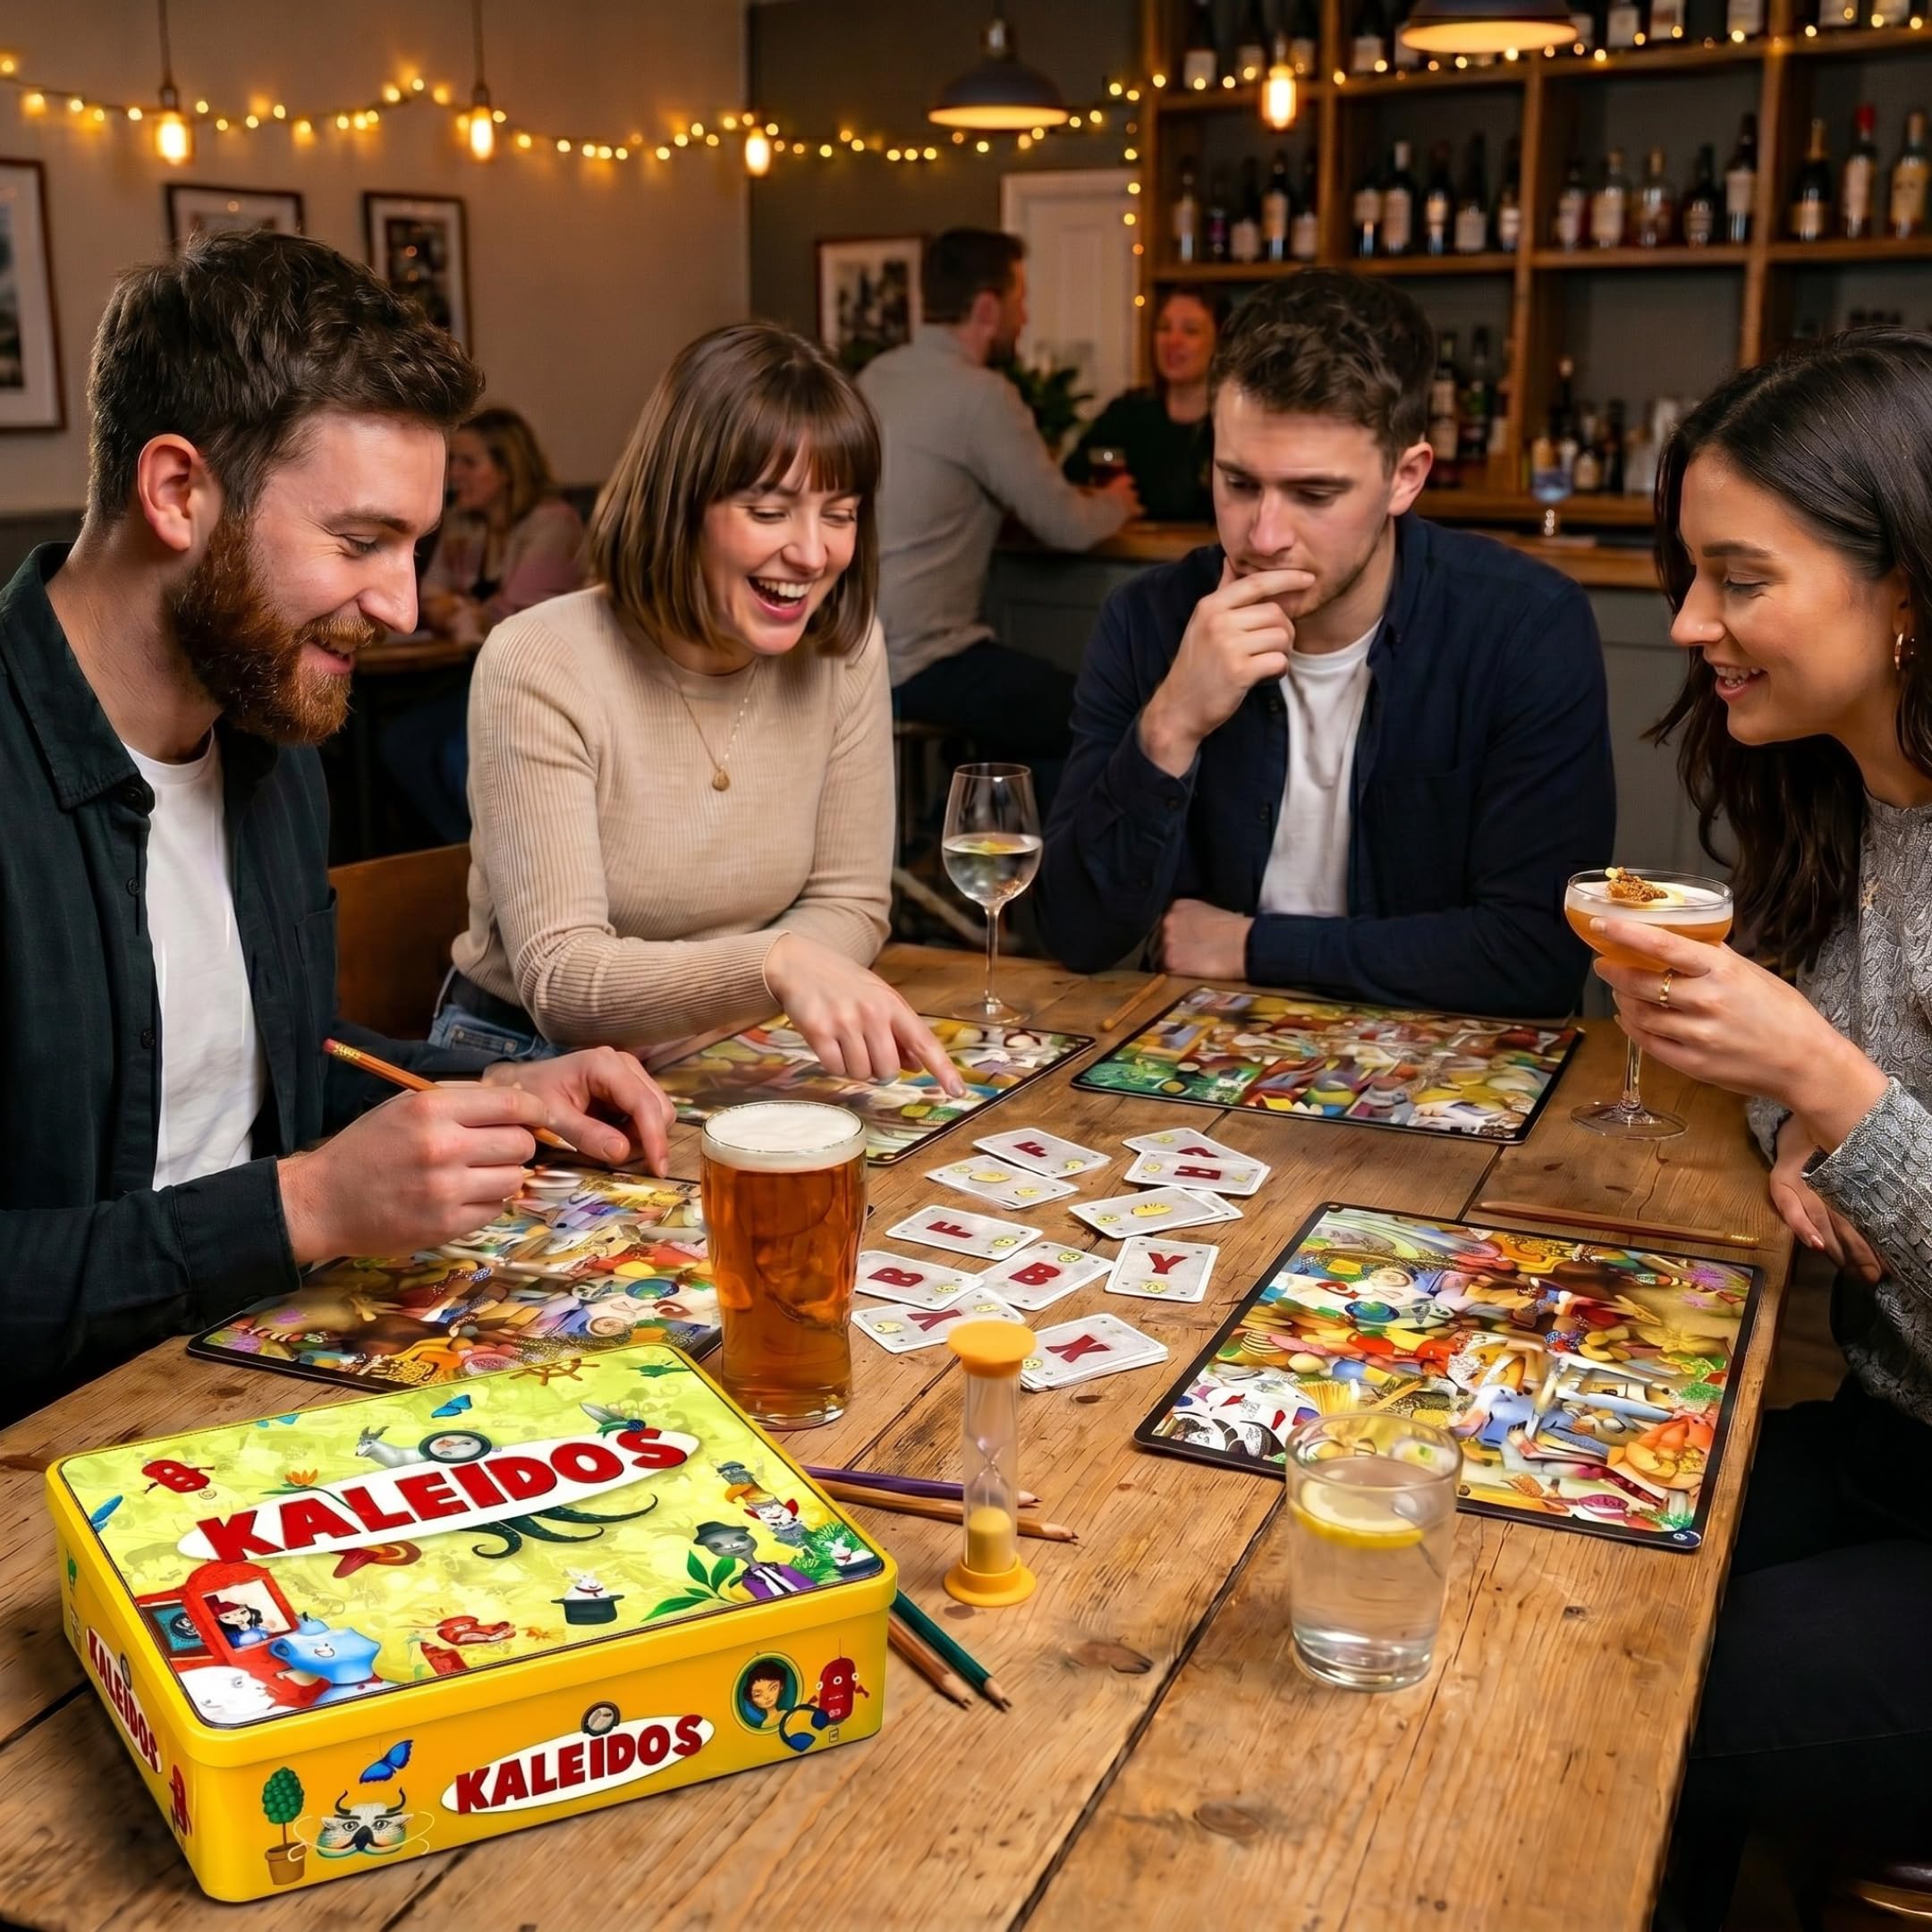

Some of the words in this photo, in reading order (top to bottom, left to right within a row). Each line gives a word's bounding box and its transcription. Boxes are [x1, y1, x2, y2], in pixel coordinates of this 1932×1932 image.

[1013, 1140, 1048, 1157] F
[926, 1221, 974, 1239] F
[1008, 1262, 1061, 1285] B
[1148, 1252, 1188, 1275] Y
[867, 1267, 924, 1287] B
[906, 1309, 962, 1332] Y
[1045, 1335, 1111, 1363] X
[195, 1427, 689, 1564] KALEIDOS
[88, 1628, 159, 1773] KALEIDOS
[455, 1714, 704, 1815] KALEIDOS
